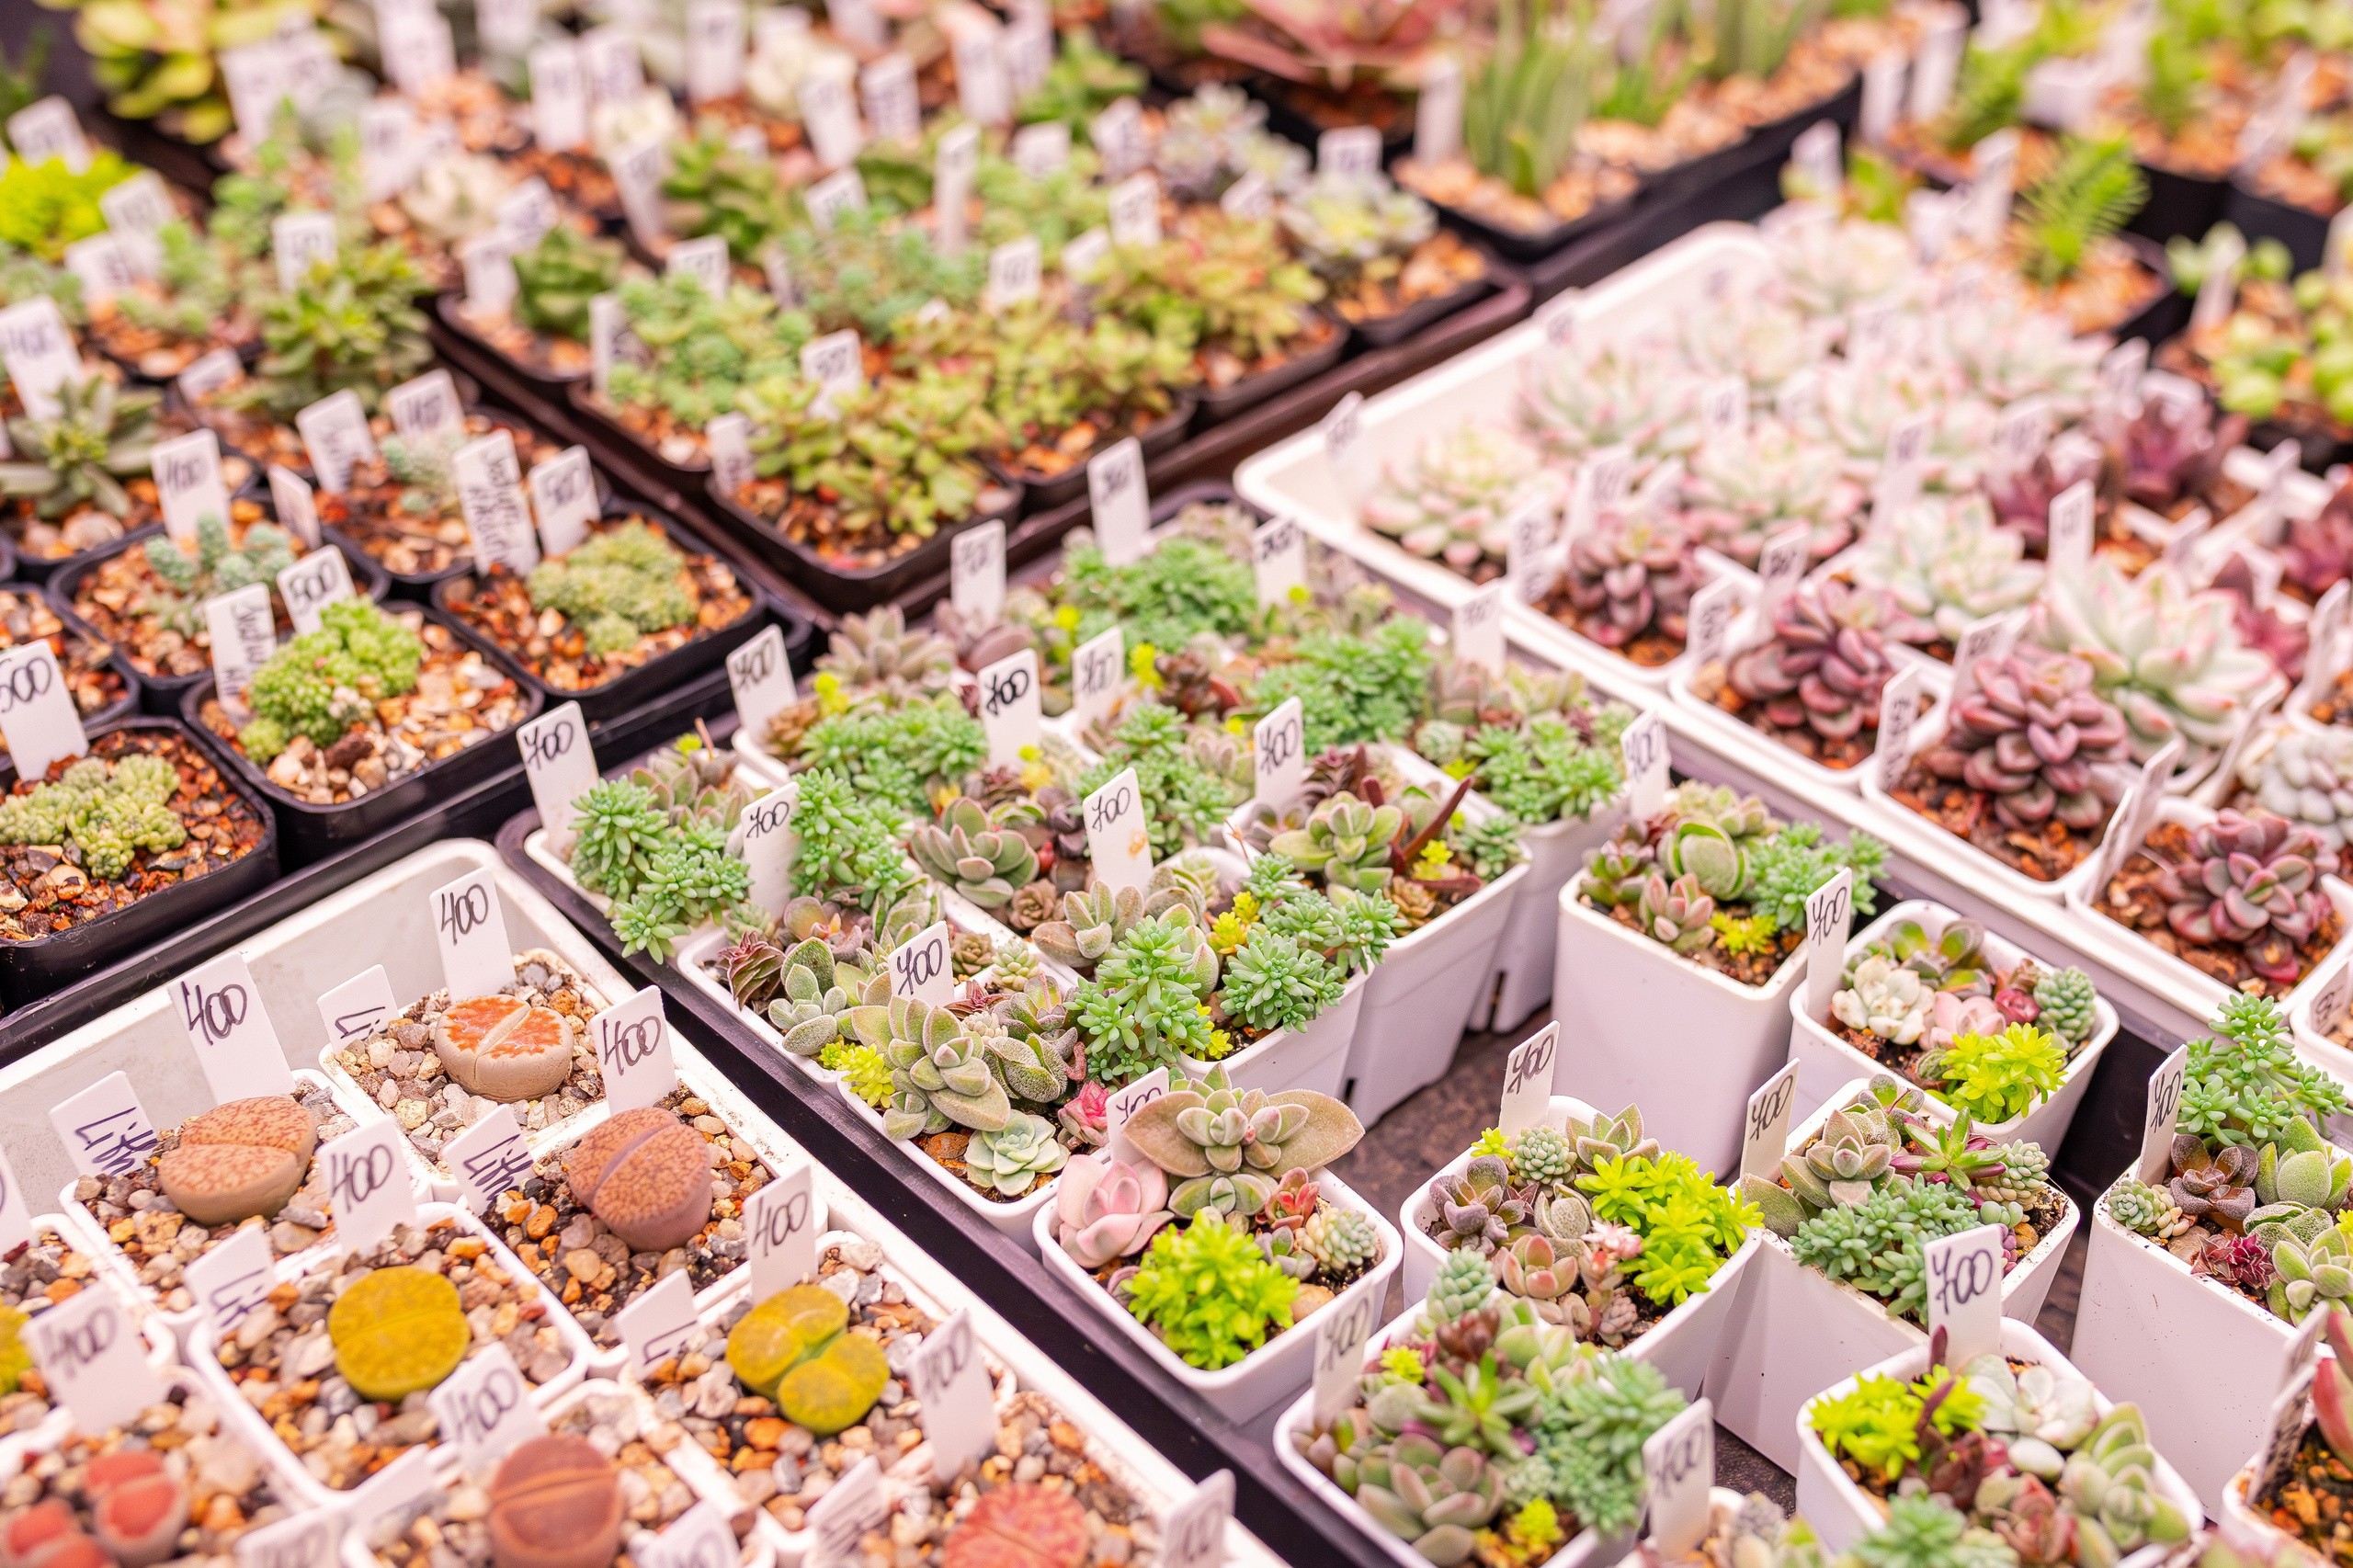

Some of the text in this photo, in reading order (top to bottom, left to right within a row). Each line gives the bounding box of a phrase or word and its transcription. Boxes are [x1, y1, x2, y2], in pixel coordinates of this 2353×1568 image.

[440, 883, 489, 946] 400
[180, 980, 247, 1046] 400
[603, 1015, 662, 1077] 400
[331, 1143, 392, 1214] 400
[752, 1189, 809, 1257] 400
[443, 1367, 519, 1444] 400
